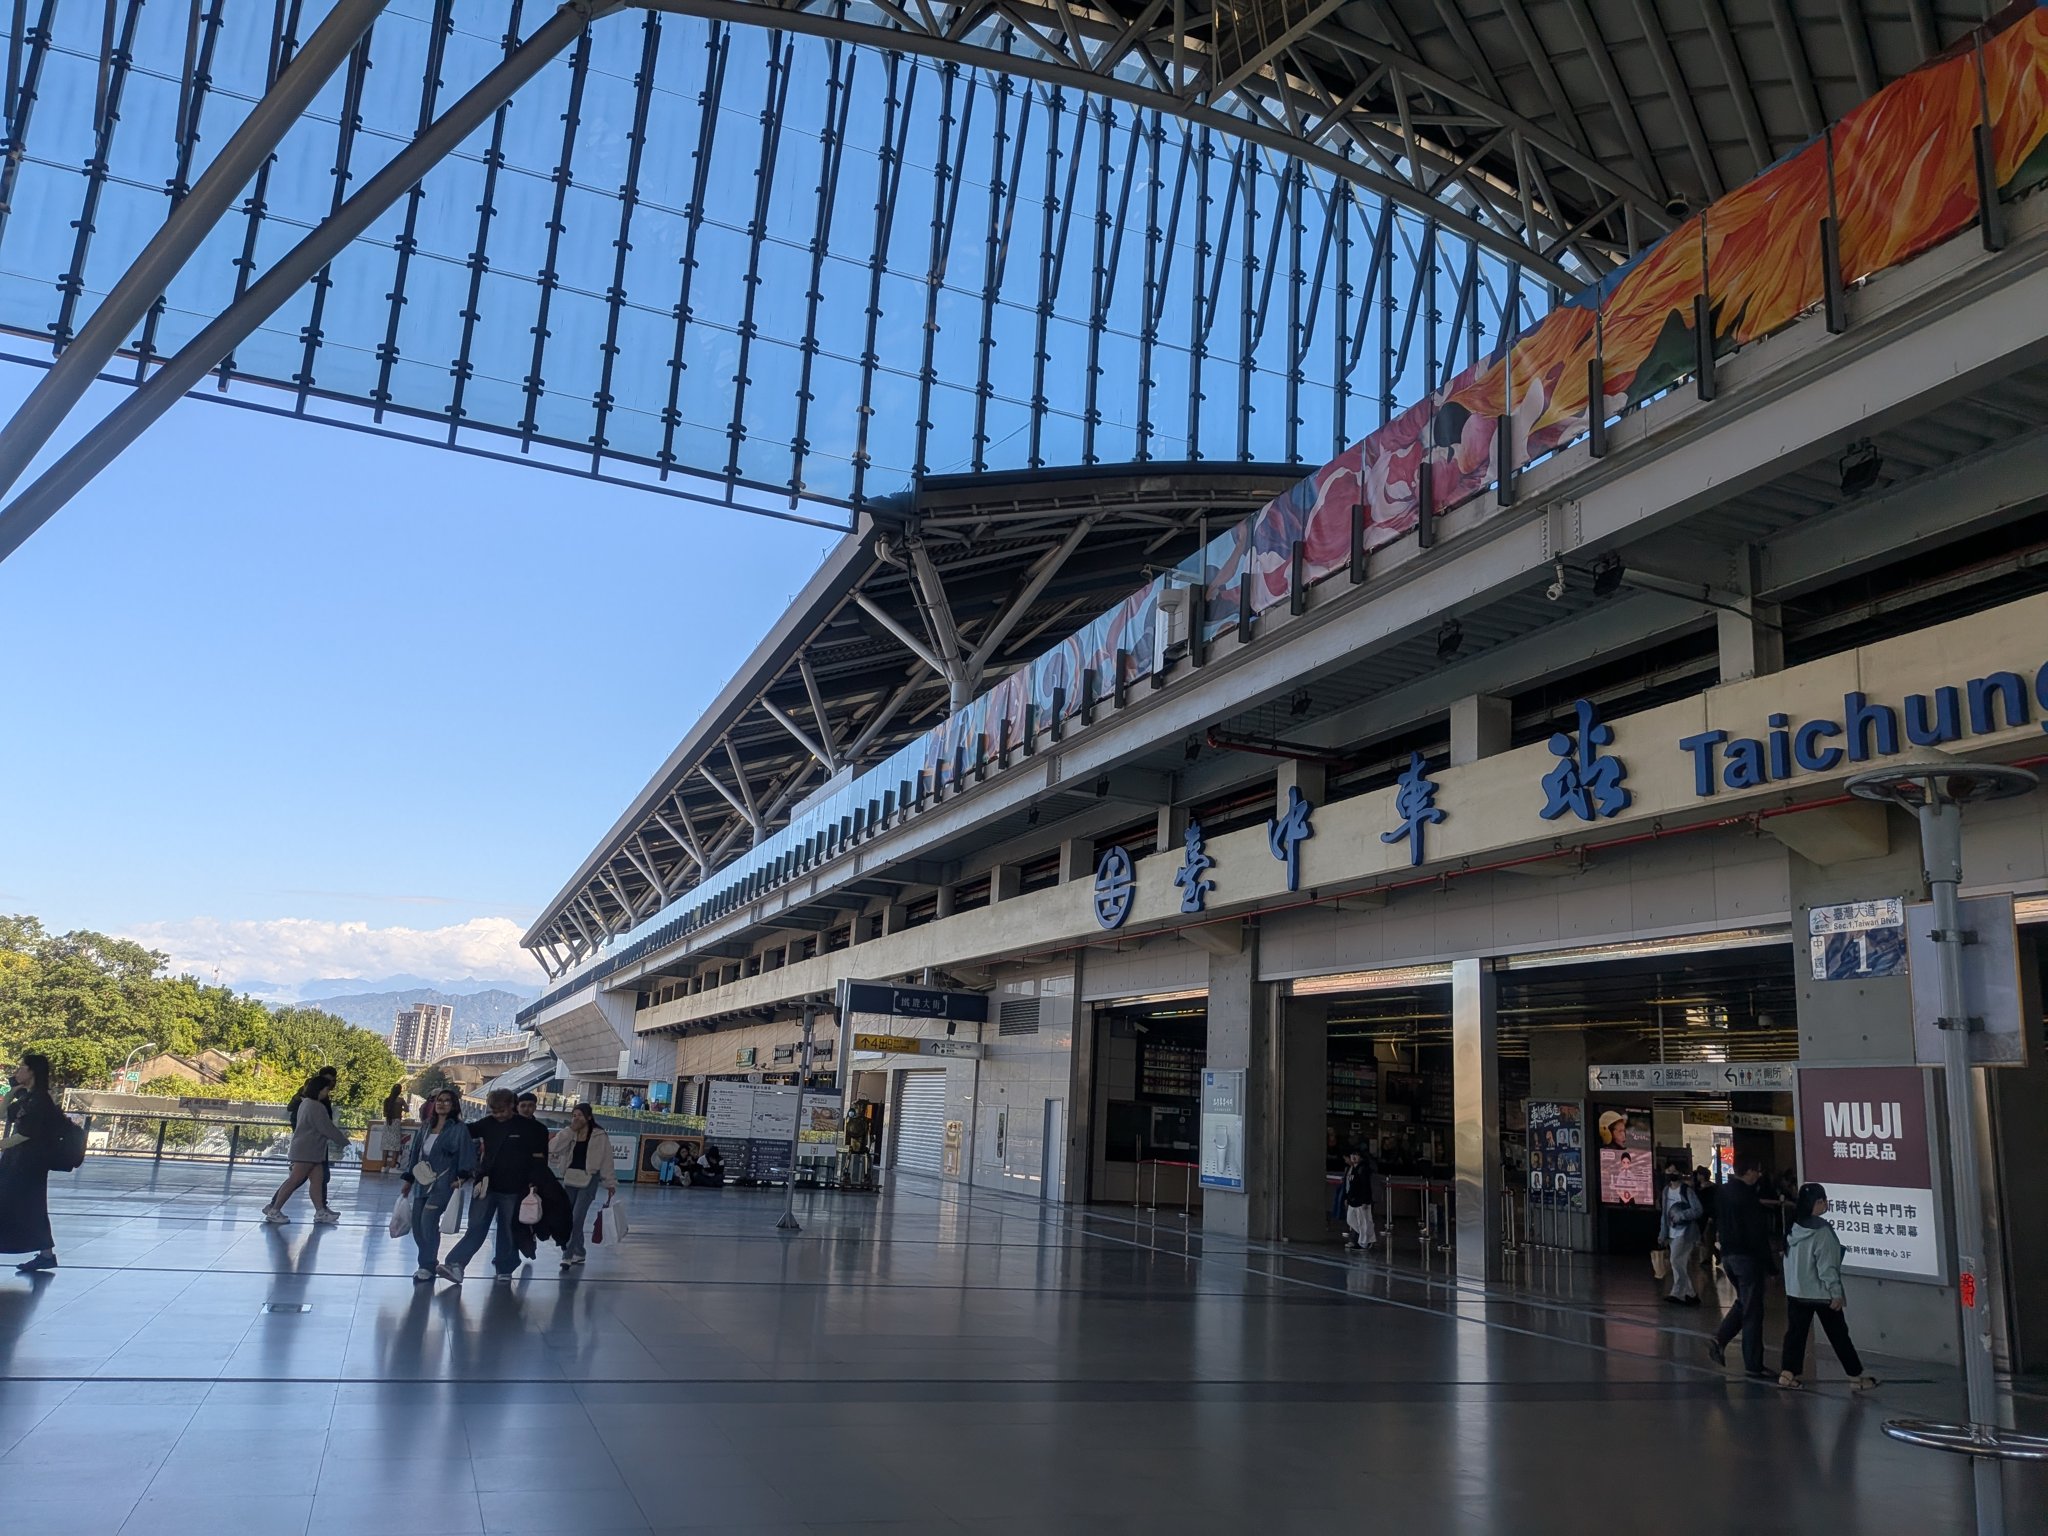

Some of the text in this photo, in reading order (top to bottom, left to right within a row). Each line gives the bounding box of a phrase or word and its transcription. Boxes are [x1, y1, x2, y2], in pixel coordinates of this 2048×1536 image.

[1680, 660, 2048, 796] Taichun
[1174, 700, 1632, 914] 臺中車站
[1833, 900, 1898, 921] 臺灣大道一段
[1854, 934, 1872, 972] 1
[1622, 1069, 1645, 1080] 售票處
[1666, 1068, 1698, 1080] 服務中心
[1823, 1102, 1903, 1139] MUJI
[1832, 1140, 1896, 1161] 無印良品
[1825, 1219, 1918, 1238] 2月23日 盛大開幕
[1846, 1245, 1912, 1259] 新時代購物中心 3F
